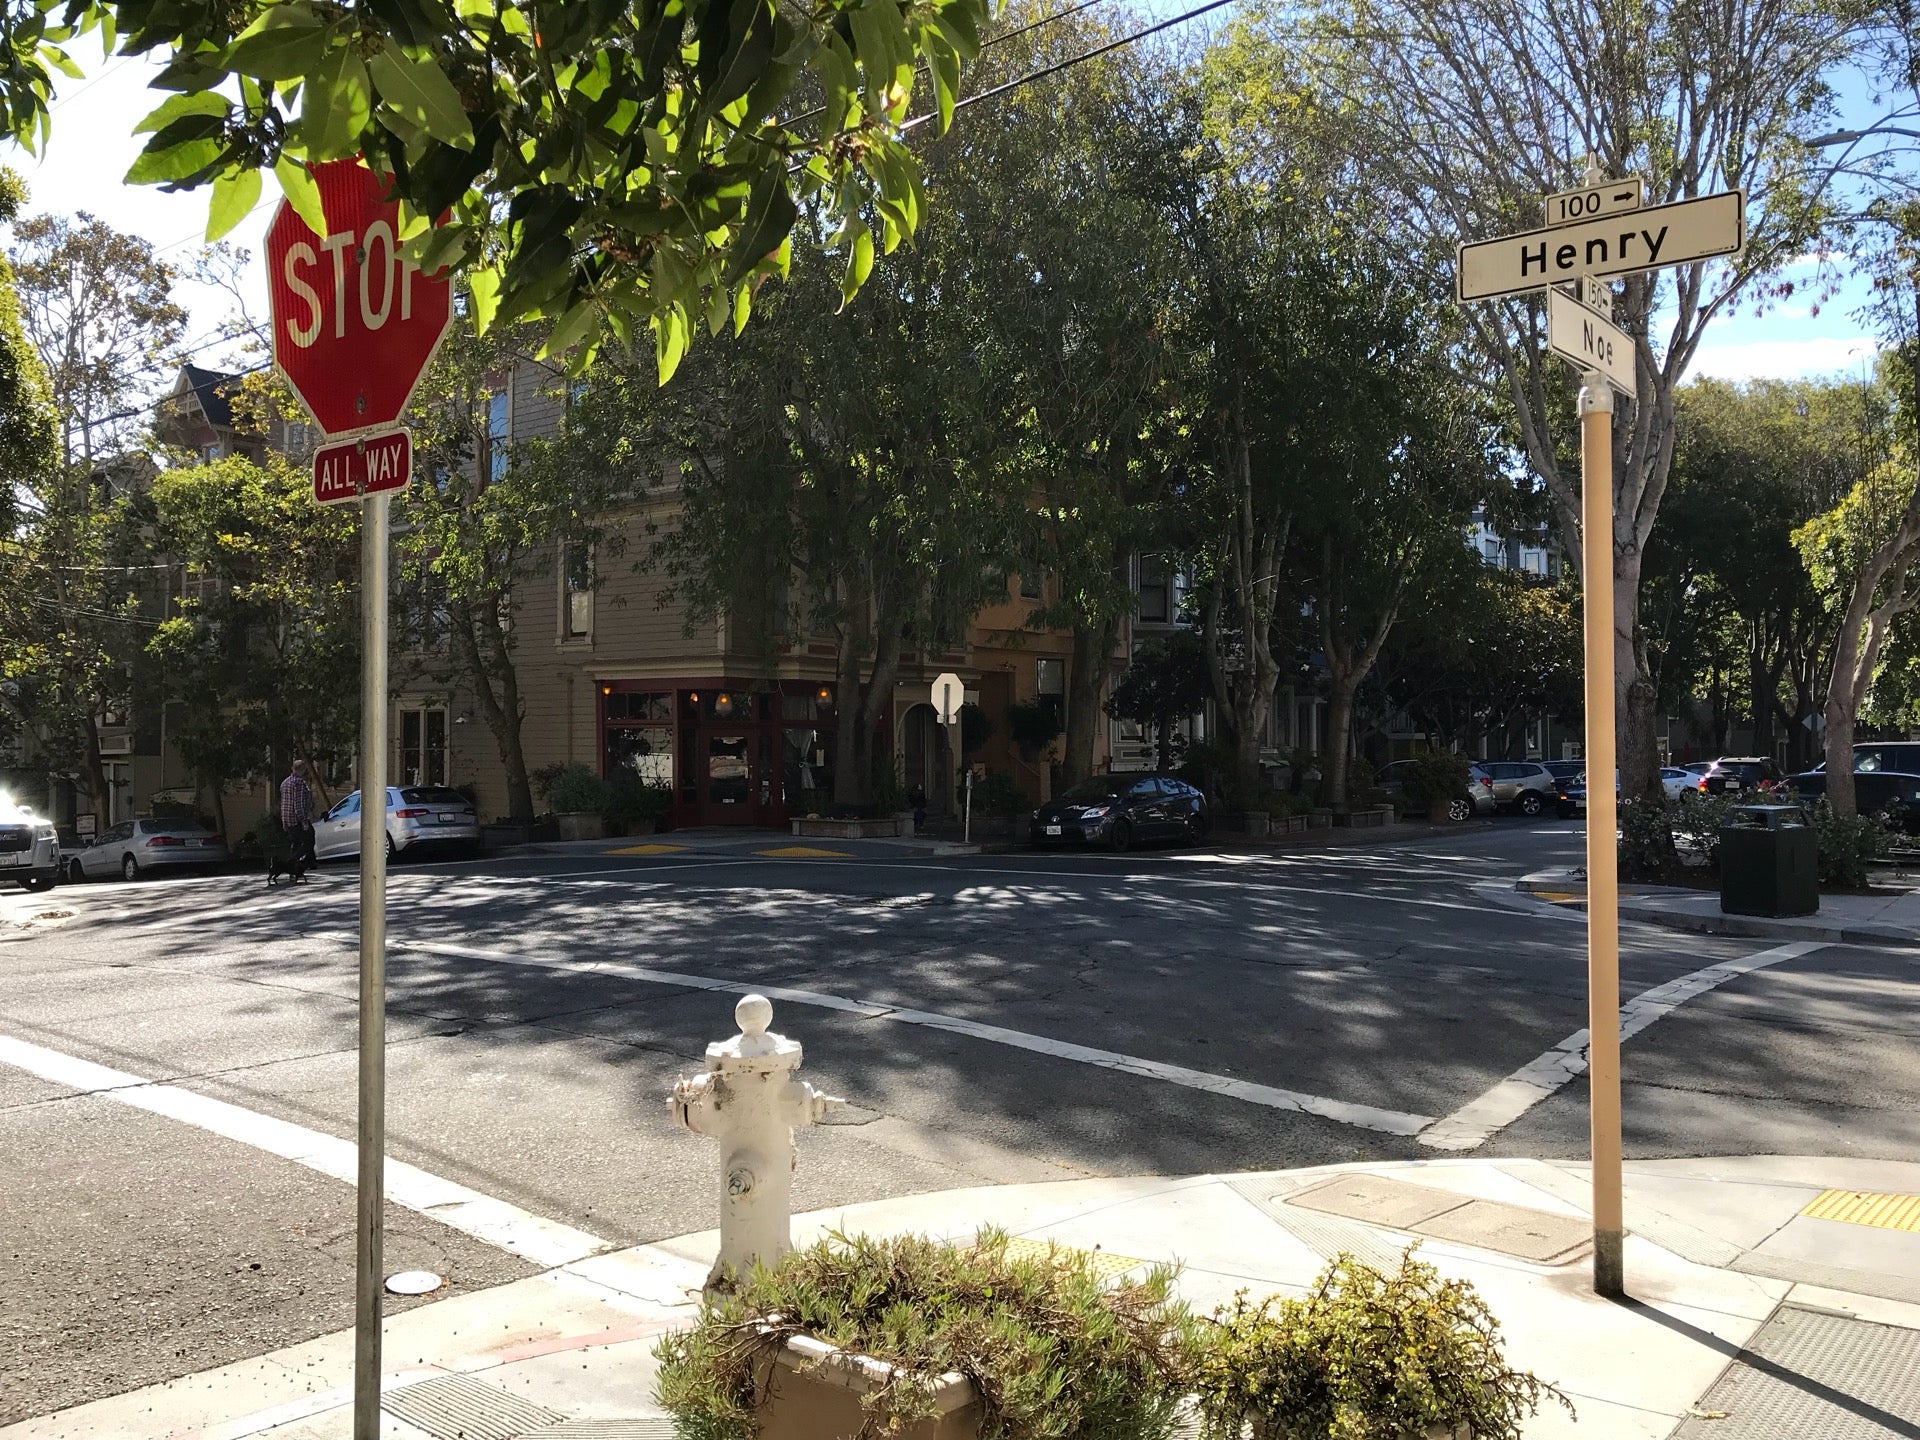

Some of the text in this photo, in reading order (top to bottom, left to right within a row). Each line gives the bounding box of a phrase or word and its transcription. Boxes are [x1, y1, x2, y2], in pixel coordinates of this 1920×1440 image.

[1560, 193, 1601, 219] 100
[1521, 226, 1669, 277] Henry
[1588, 280, 1603, 309] 150
[1583, 319, 1613, 366] Noe
[321, 443, 402, 492] ALL WAY
